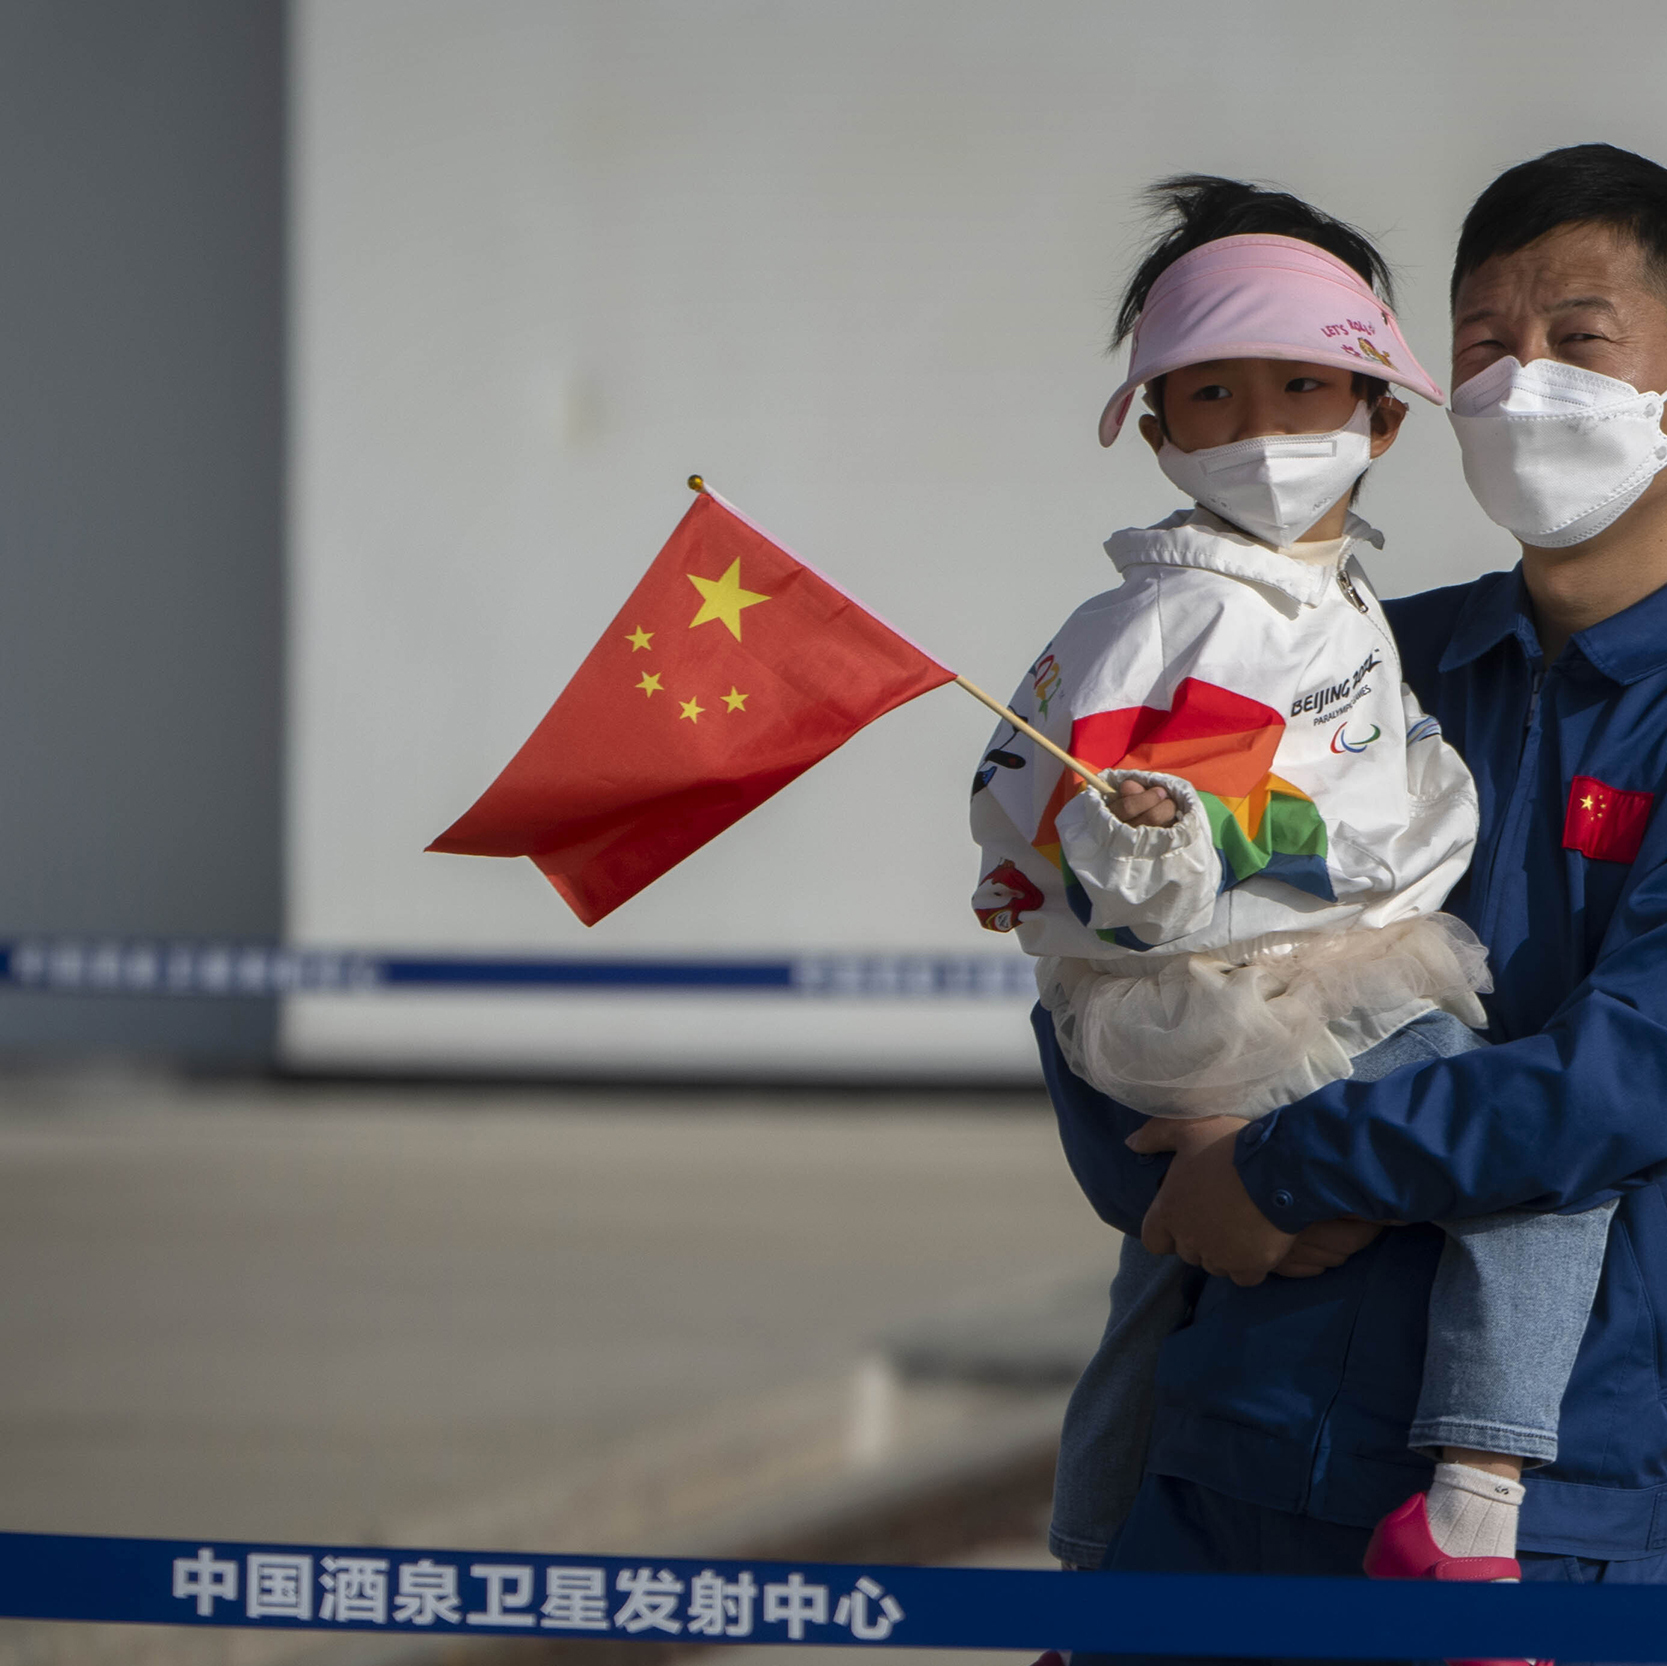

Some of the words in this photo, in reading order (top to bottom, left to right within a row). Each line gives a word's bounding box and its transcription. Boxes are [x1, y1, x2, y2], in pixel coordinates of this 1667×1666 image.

[1290, 679, 1350, 717] BEIJING
[172, 1547, 906, 1643] 中国酒泉卫星发射中心
